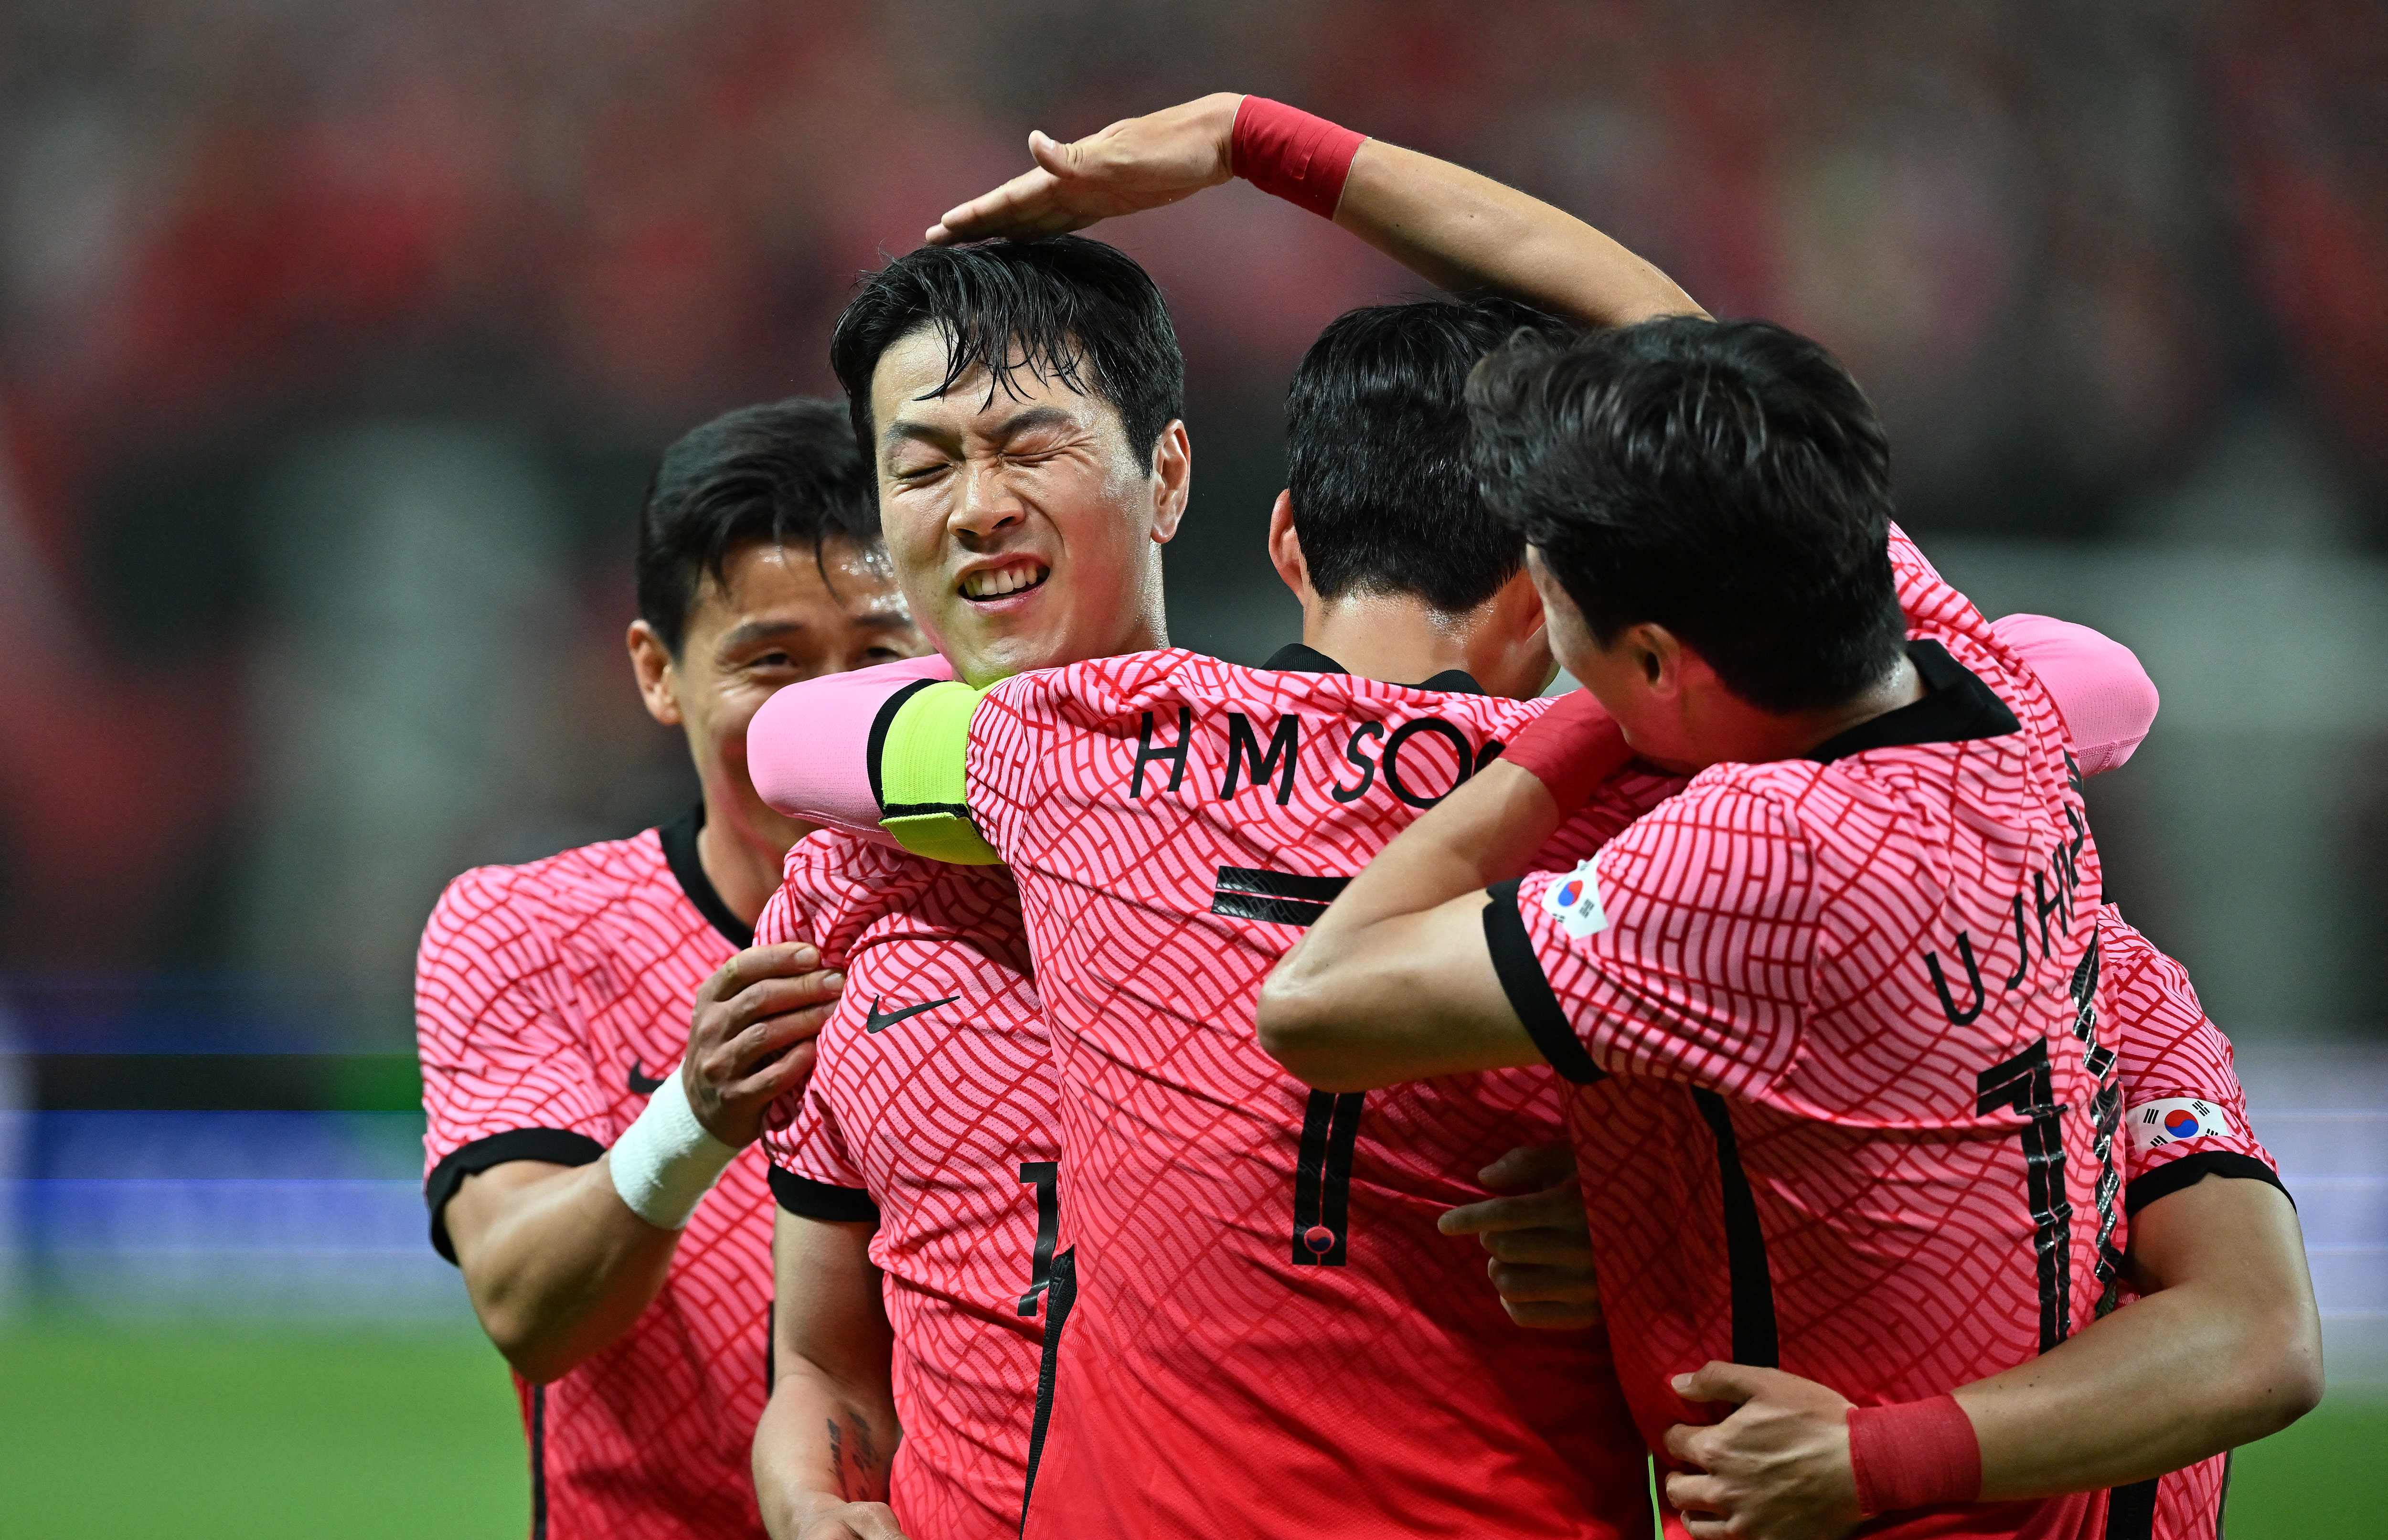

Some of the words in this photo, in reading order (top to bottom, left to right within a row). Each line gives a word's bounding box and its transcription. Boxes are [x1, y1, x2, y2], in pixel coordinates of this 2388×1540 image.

[1129, 707, 1191, 798] H
[1220, 712, 1300, 806] M
[1332, 717, 1506, 809] SO
[1210, 865, 1366, 1267] 7
